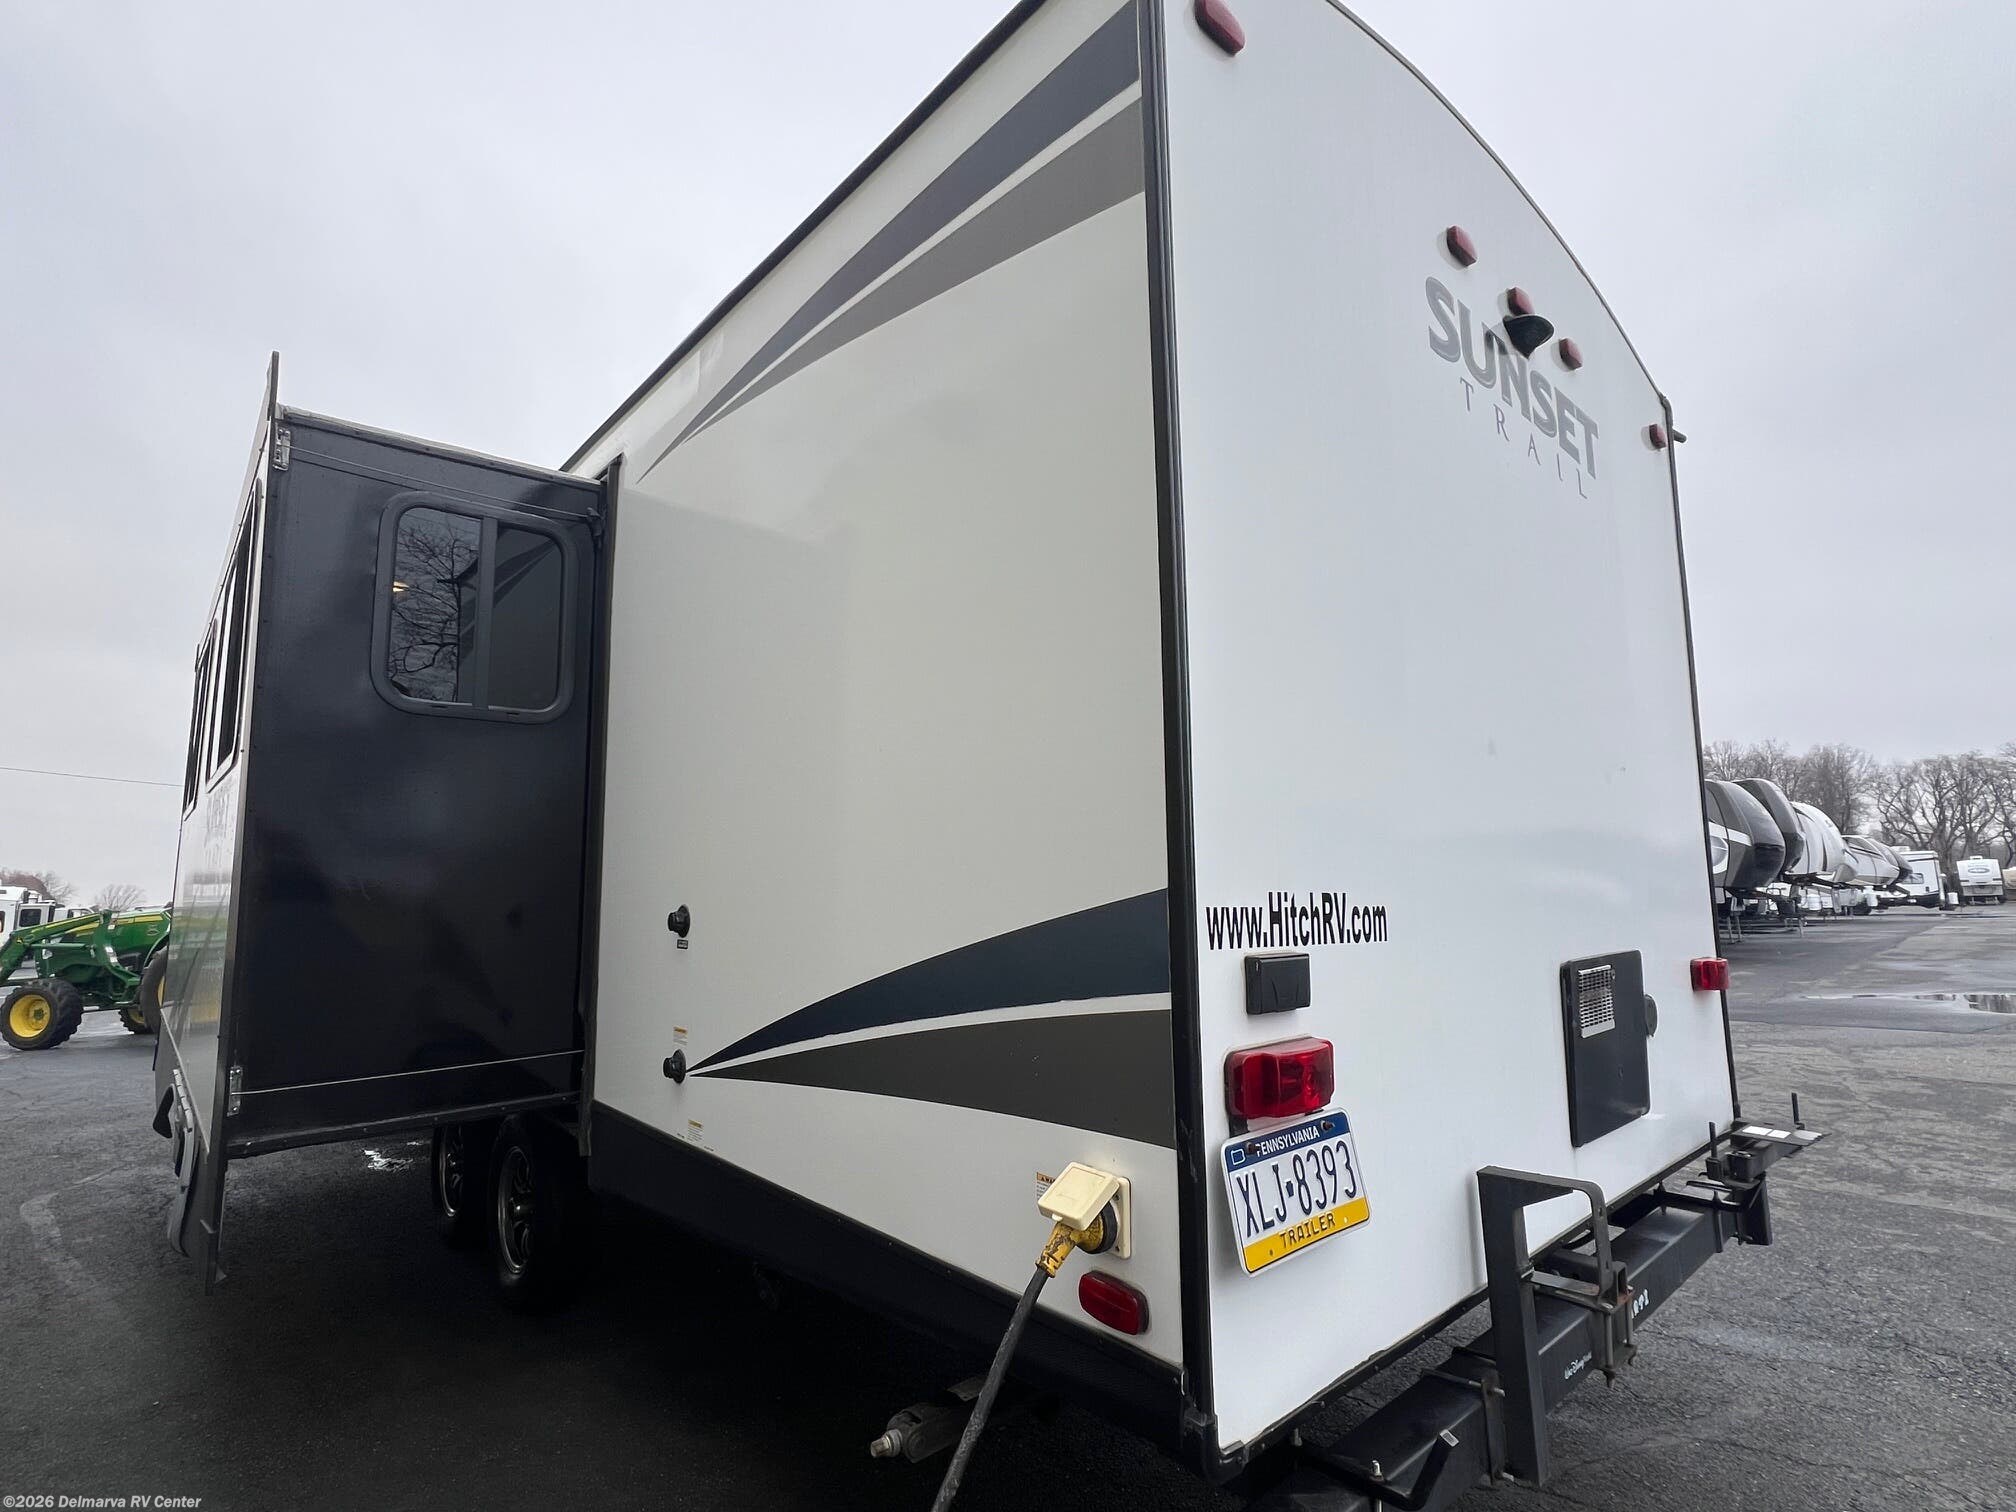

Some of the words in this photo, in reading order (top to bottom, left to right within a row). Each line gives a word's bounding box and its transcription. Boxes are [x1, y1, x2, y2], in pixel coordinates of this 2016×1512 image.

[1425, 276, 1600, 481] SUNSET
[1460, 376, 1588, 500] TRAIL
[1206, 891, 1388, 951] www.HitchRV.com
[1256, 1125, 1321, 1158] PENNSYLVANIA
[1279, 1211, 1337, 1249] TRAILER
